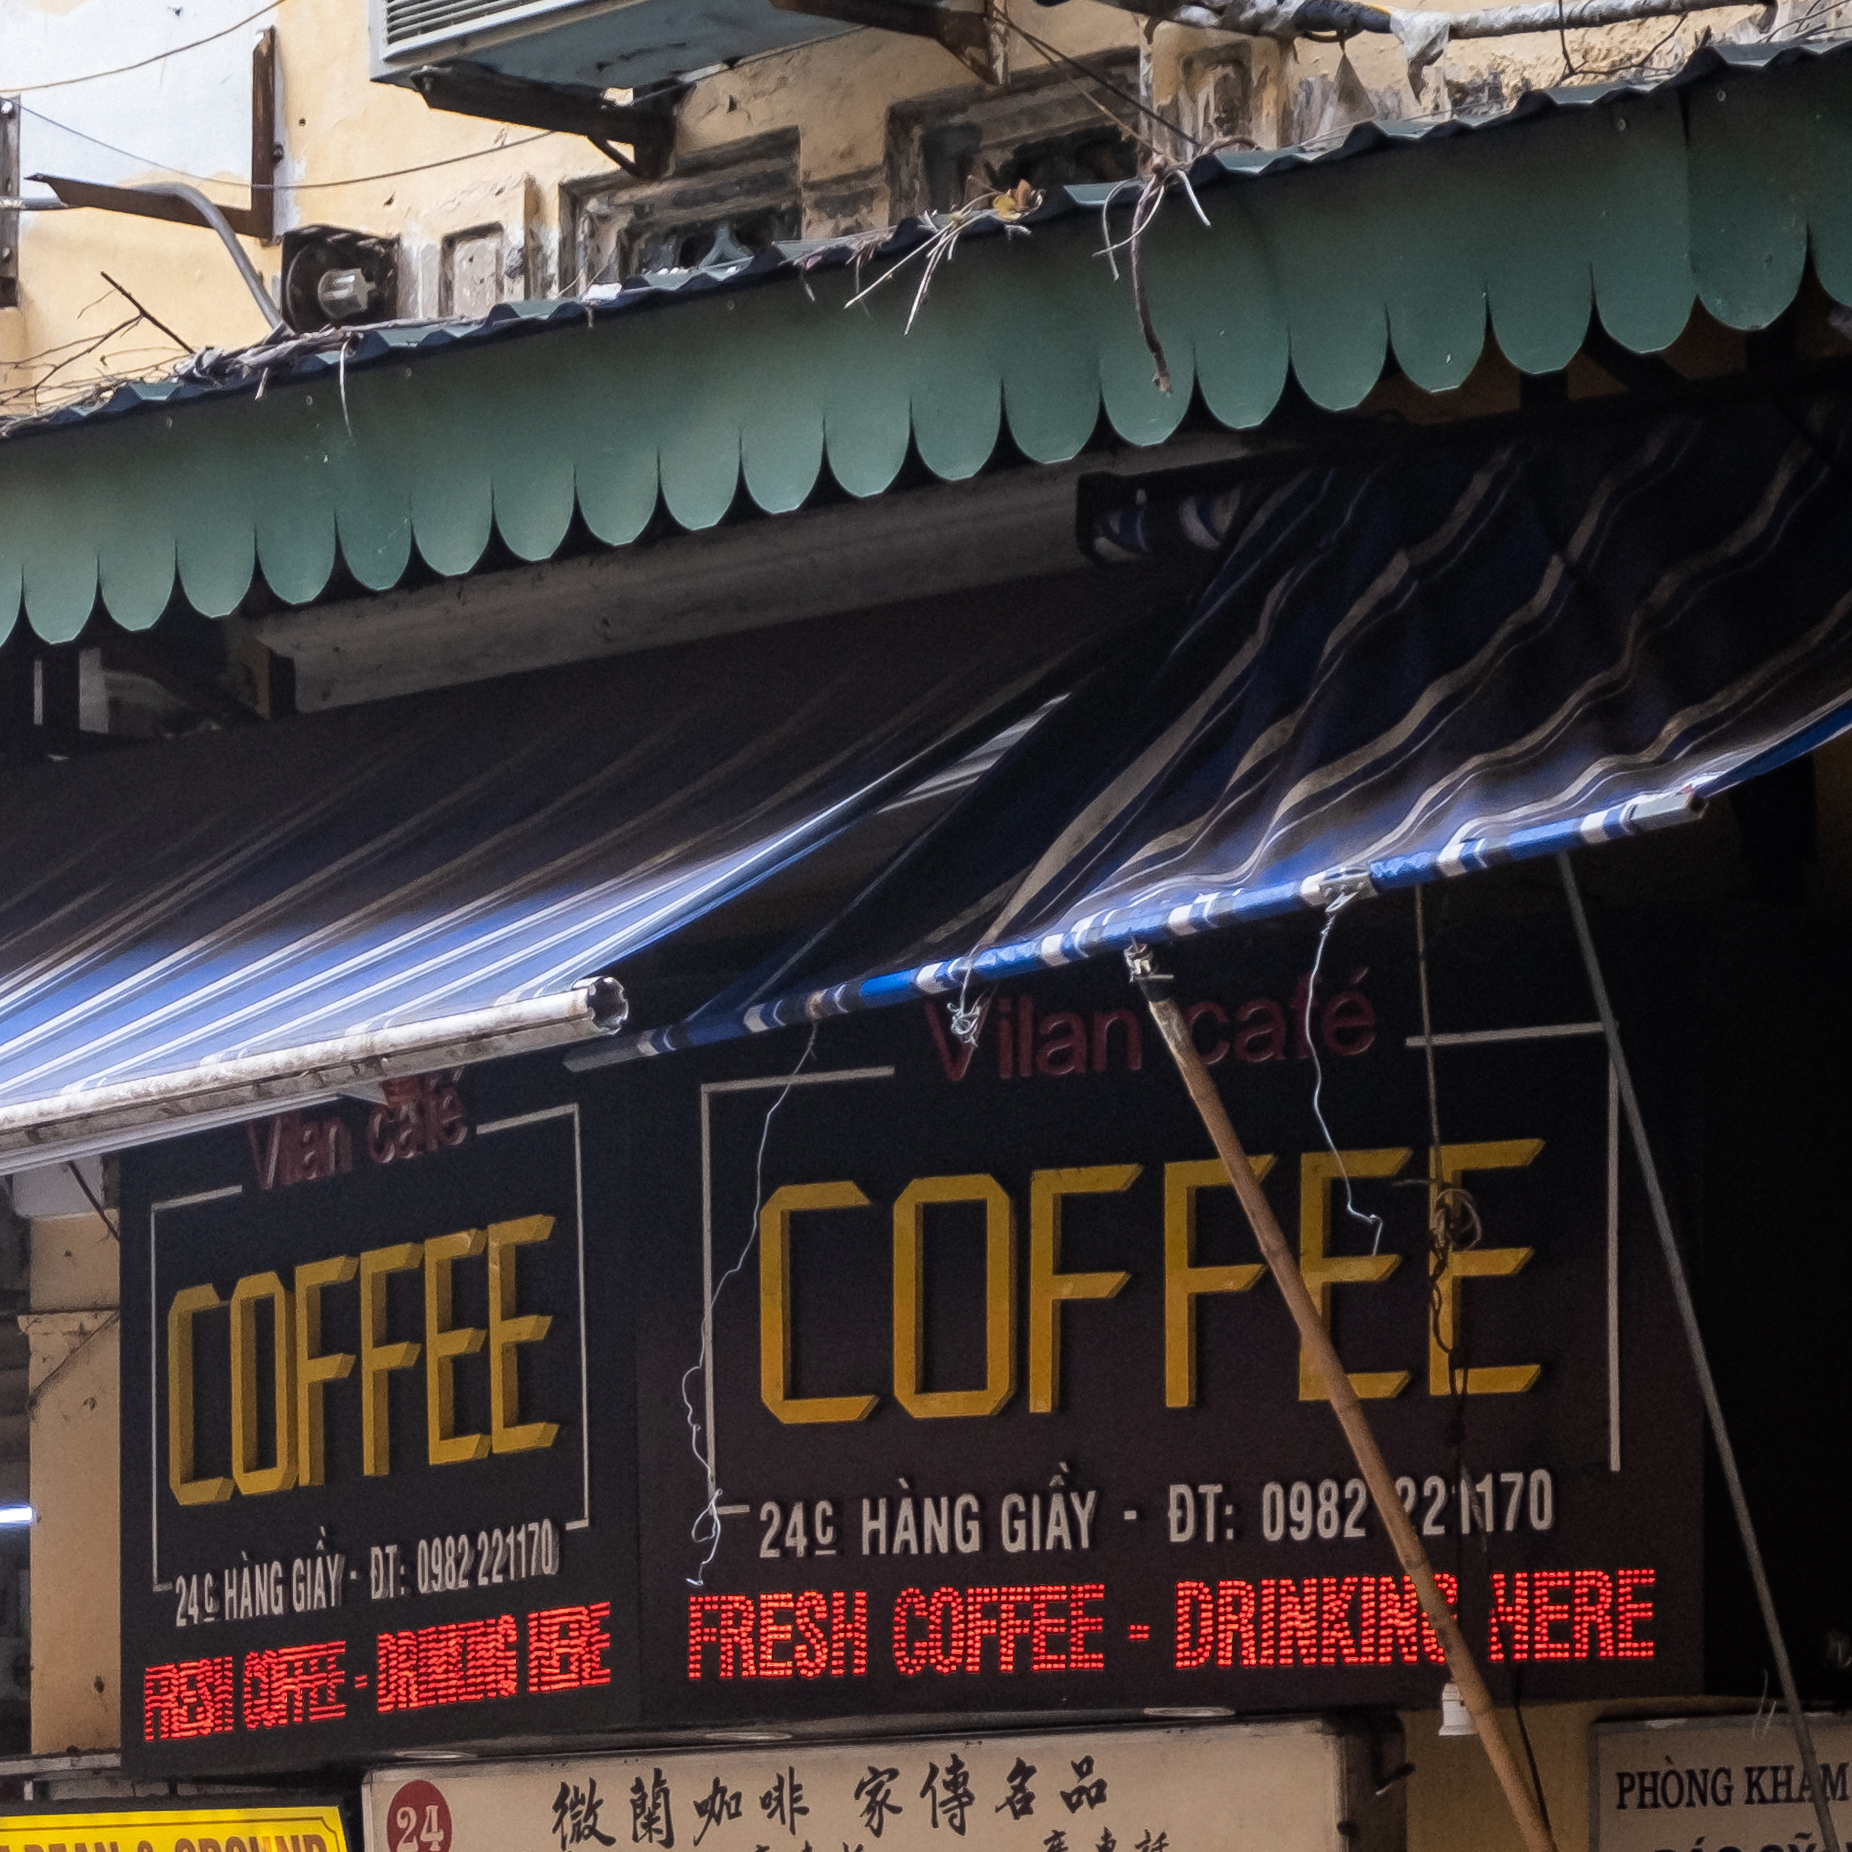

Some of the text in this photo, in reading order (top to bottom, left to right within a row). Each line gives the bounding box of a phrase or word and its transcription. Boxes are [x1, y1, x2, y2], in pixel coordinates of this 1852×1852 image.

[926, 966, 1376, 1081] Vilan café
[760, 1139, 1547, 1424] COFFEE
[167, 1213, 560, 1506] COFFEE
[224, 1550, 287, 1620] HÀNG
[370, 1541, 409, 1600] ĐT:
[417, 1532, 469, 1593] 0982
[471, 1518, 557, 1584] 221170
[862, 1476, 982, 1555] HÀNG
[1169, 1480, 1237, 1545] ĐT:
[1261, 1476, 1368, 1541] 0982
[143, 1657, 233, 1742] FRESH
[243, 1639, 348, 1732] COFFEE
[528, 1602, 613, 1693] HERE
[687, 1591, 870, 1679] FRESH
[893, 1583, 1107, 1676] COFFEE
[1173, 1572, 1457, 1670] DRINKING
[1489, 1568, 1657, 1664] HERE
[855, 1754, 1111, 1838] 家傳名品
[1616, 1754, 1733, 1811] PHÒNG
